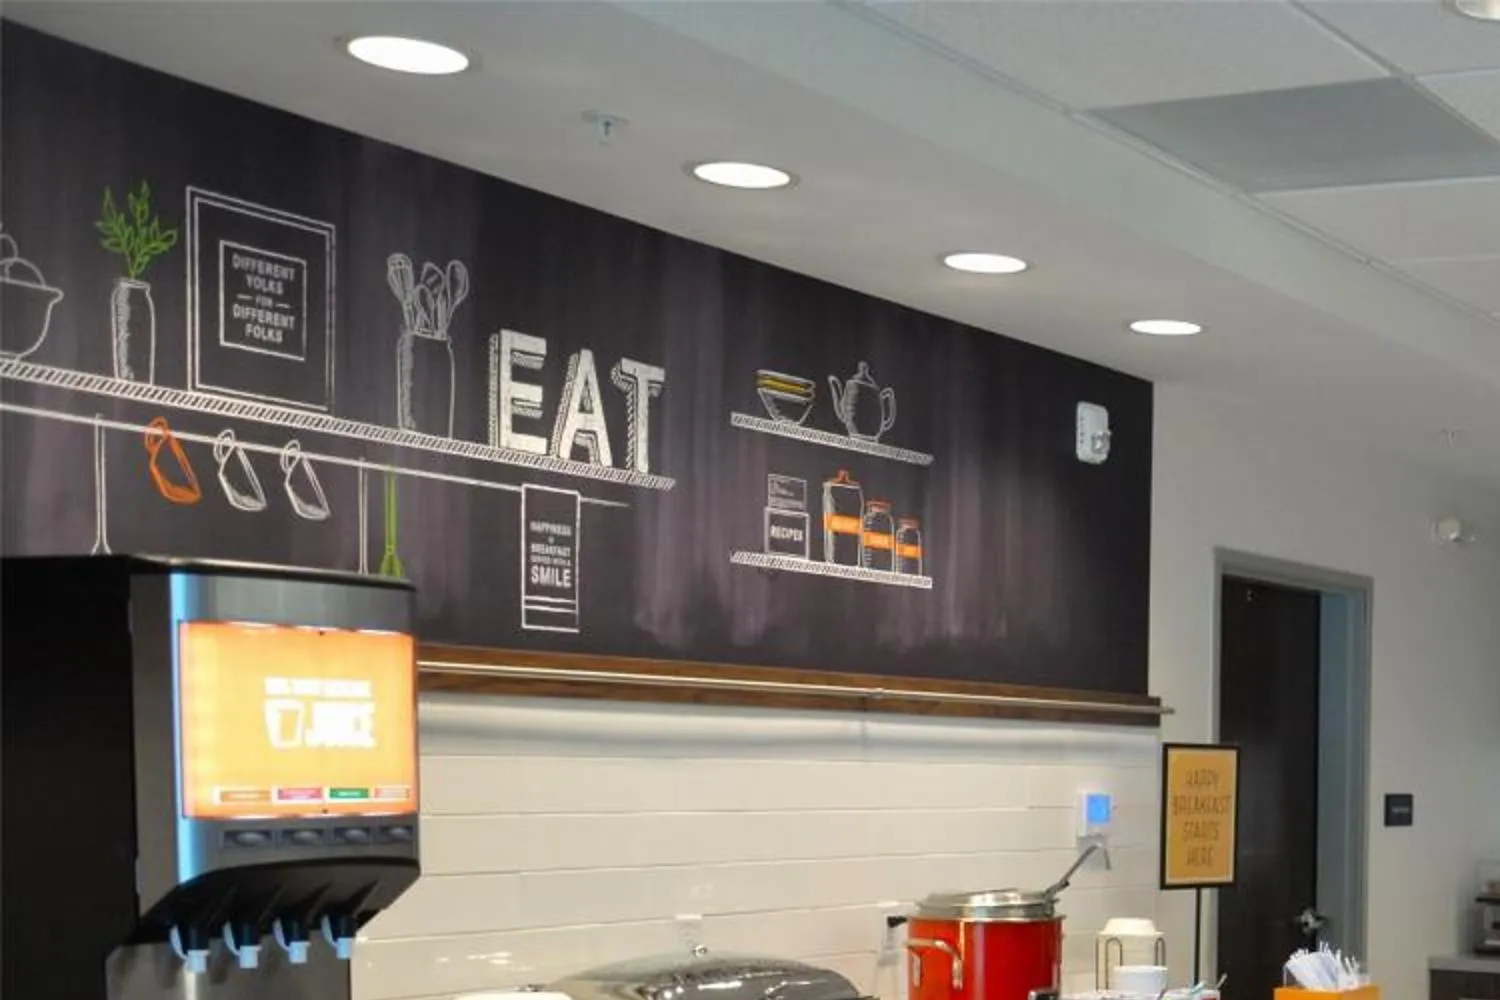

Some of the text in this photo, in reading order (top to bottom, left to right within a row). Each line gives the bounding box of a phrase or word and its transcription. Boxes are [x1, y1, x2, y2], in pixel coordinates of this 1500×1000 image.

[232, 252, 296, 281] DIFFERENT
[246, 273, 284, 296] YOLKS
[232, 303, 296, 330] DIFFERENT
[245, 323, 283, 344] FOLKS
[489, 328, 665, 474] EAT
[531, 564, 572, 588] SMILE
